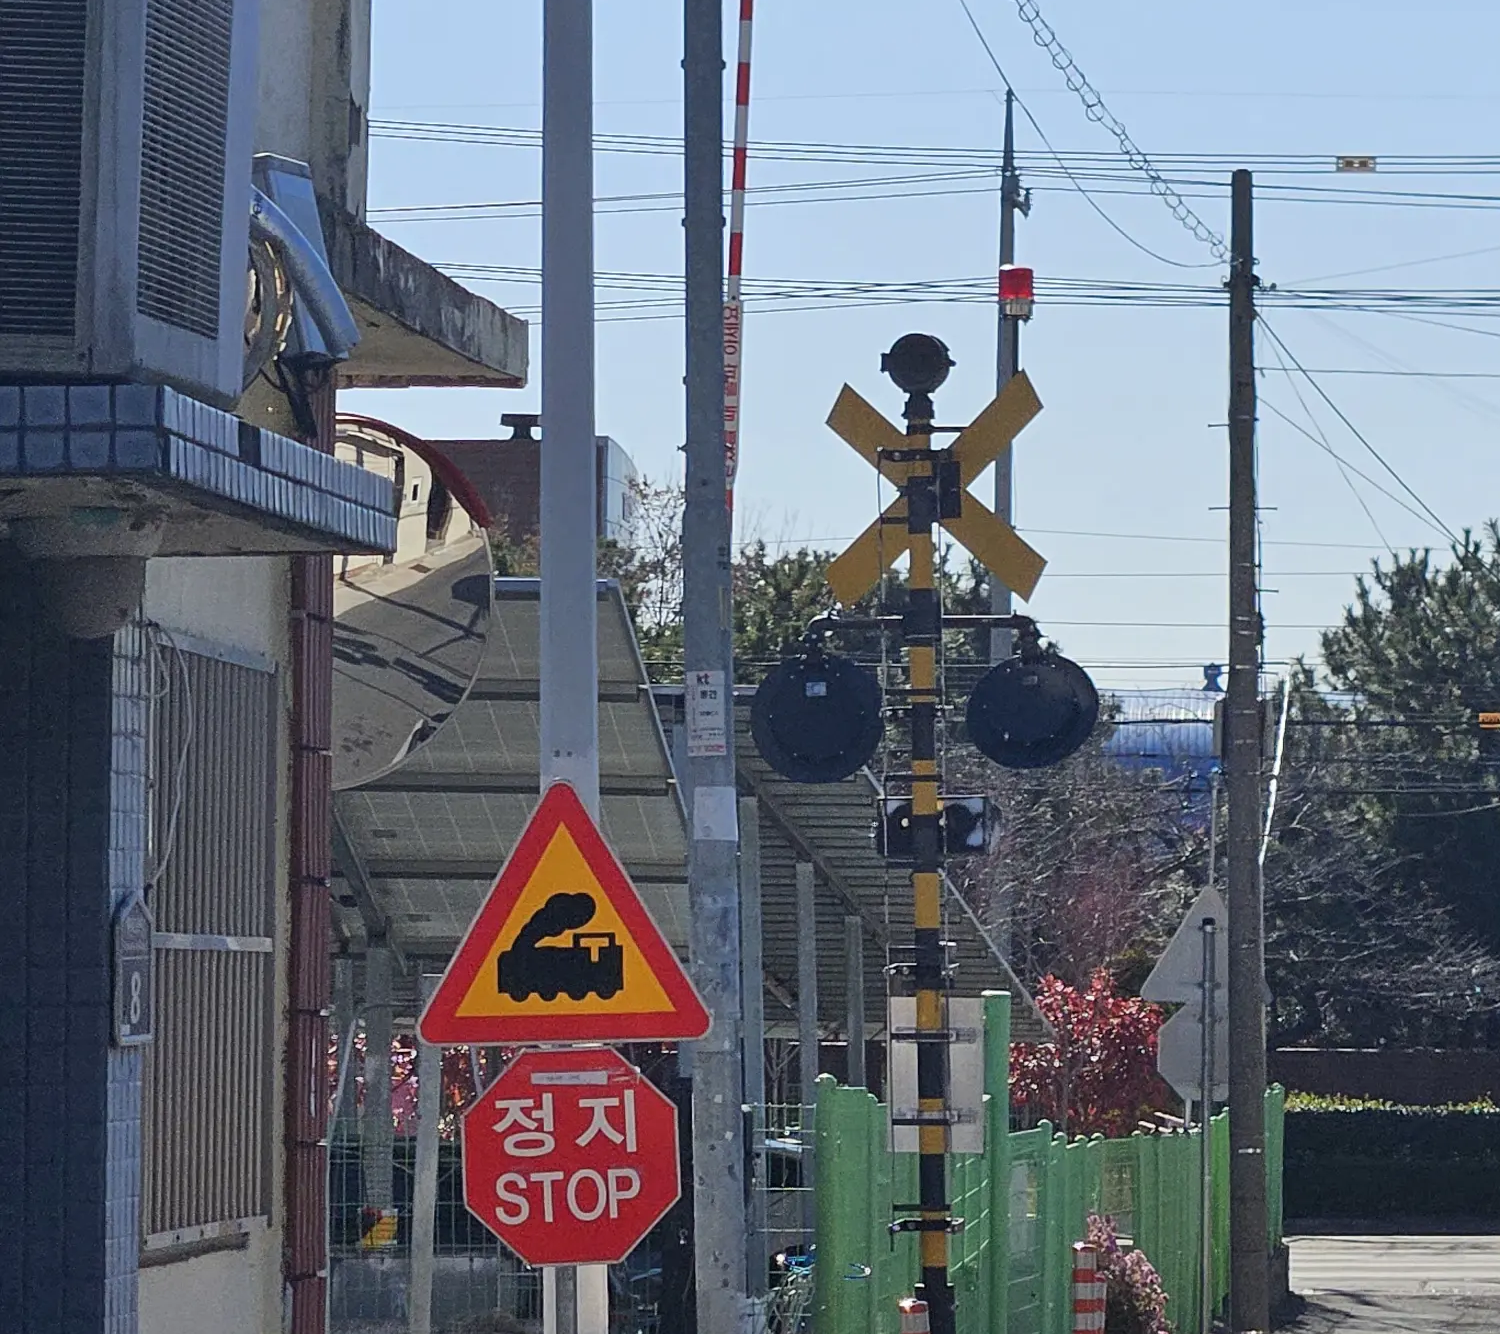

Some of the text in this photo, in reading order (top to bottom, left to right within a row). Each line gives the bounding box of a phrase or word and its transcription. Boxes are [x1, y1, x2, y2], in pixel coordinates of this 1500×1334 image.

[696, 672, 710, 685] kt
[491, 1088, 637, 1157] 정지
[495, 1168, 641, 1225] STOP
